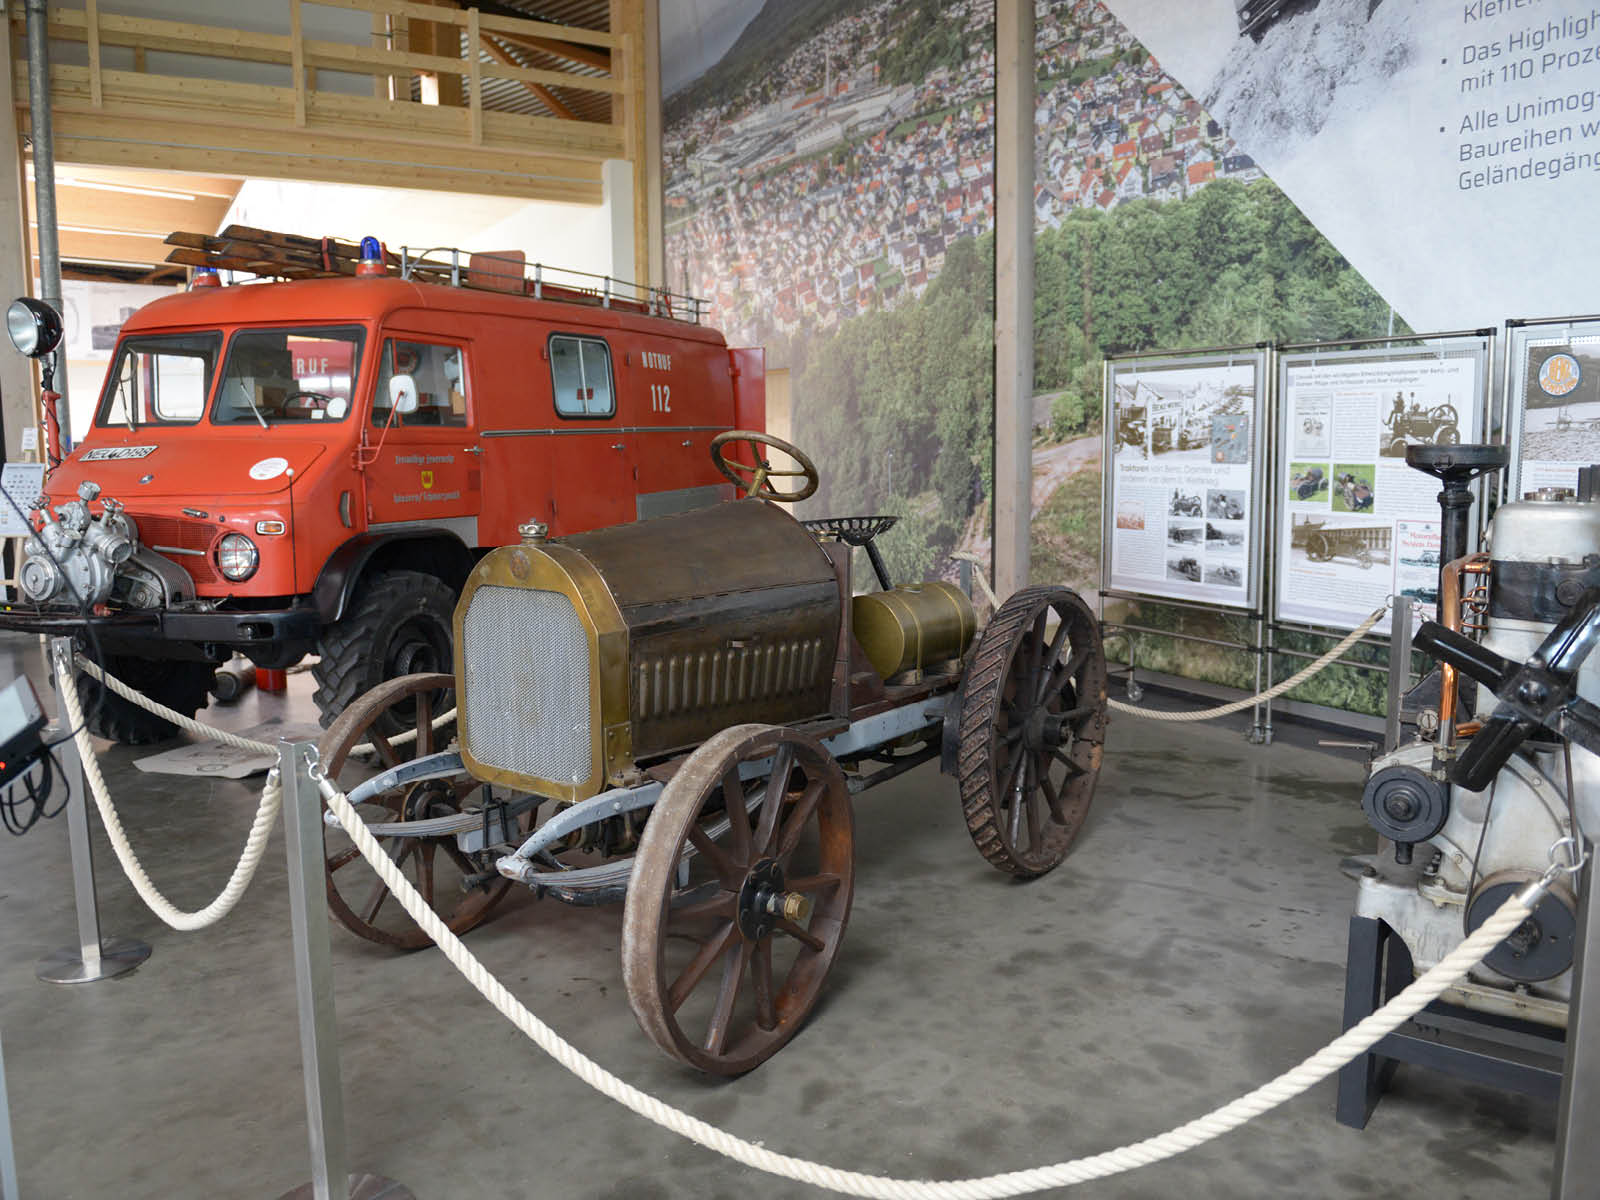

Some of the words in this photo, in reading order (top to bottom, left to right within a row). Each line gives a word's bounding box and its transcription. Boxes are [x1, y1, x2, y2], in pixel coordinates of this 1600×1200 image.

[1463, 42, 1501, 65] Das
[1461, 69, 1495, 93] mit
[1501, 58, 1534, 83] 110
[1459, 110, 1499, 135] Alle
[1460, 126, 1572, 162] Baureihen
[296, 358, 329, 375] RUF
[641, 351, 672, 370] NOTRUF
[651, 384, 671, 413] 112
